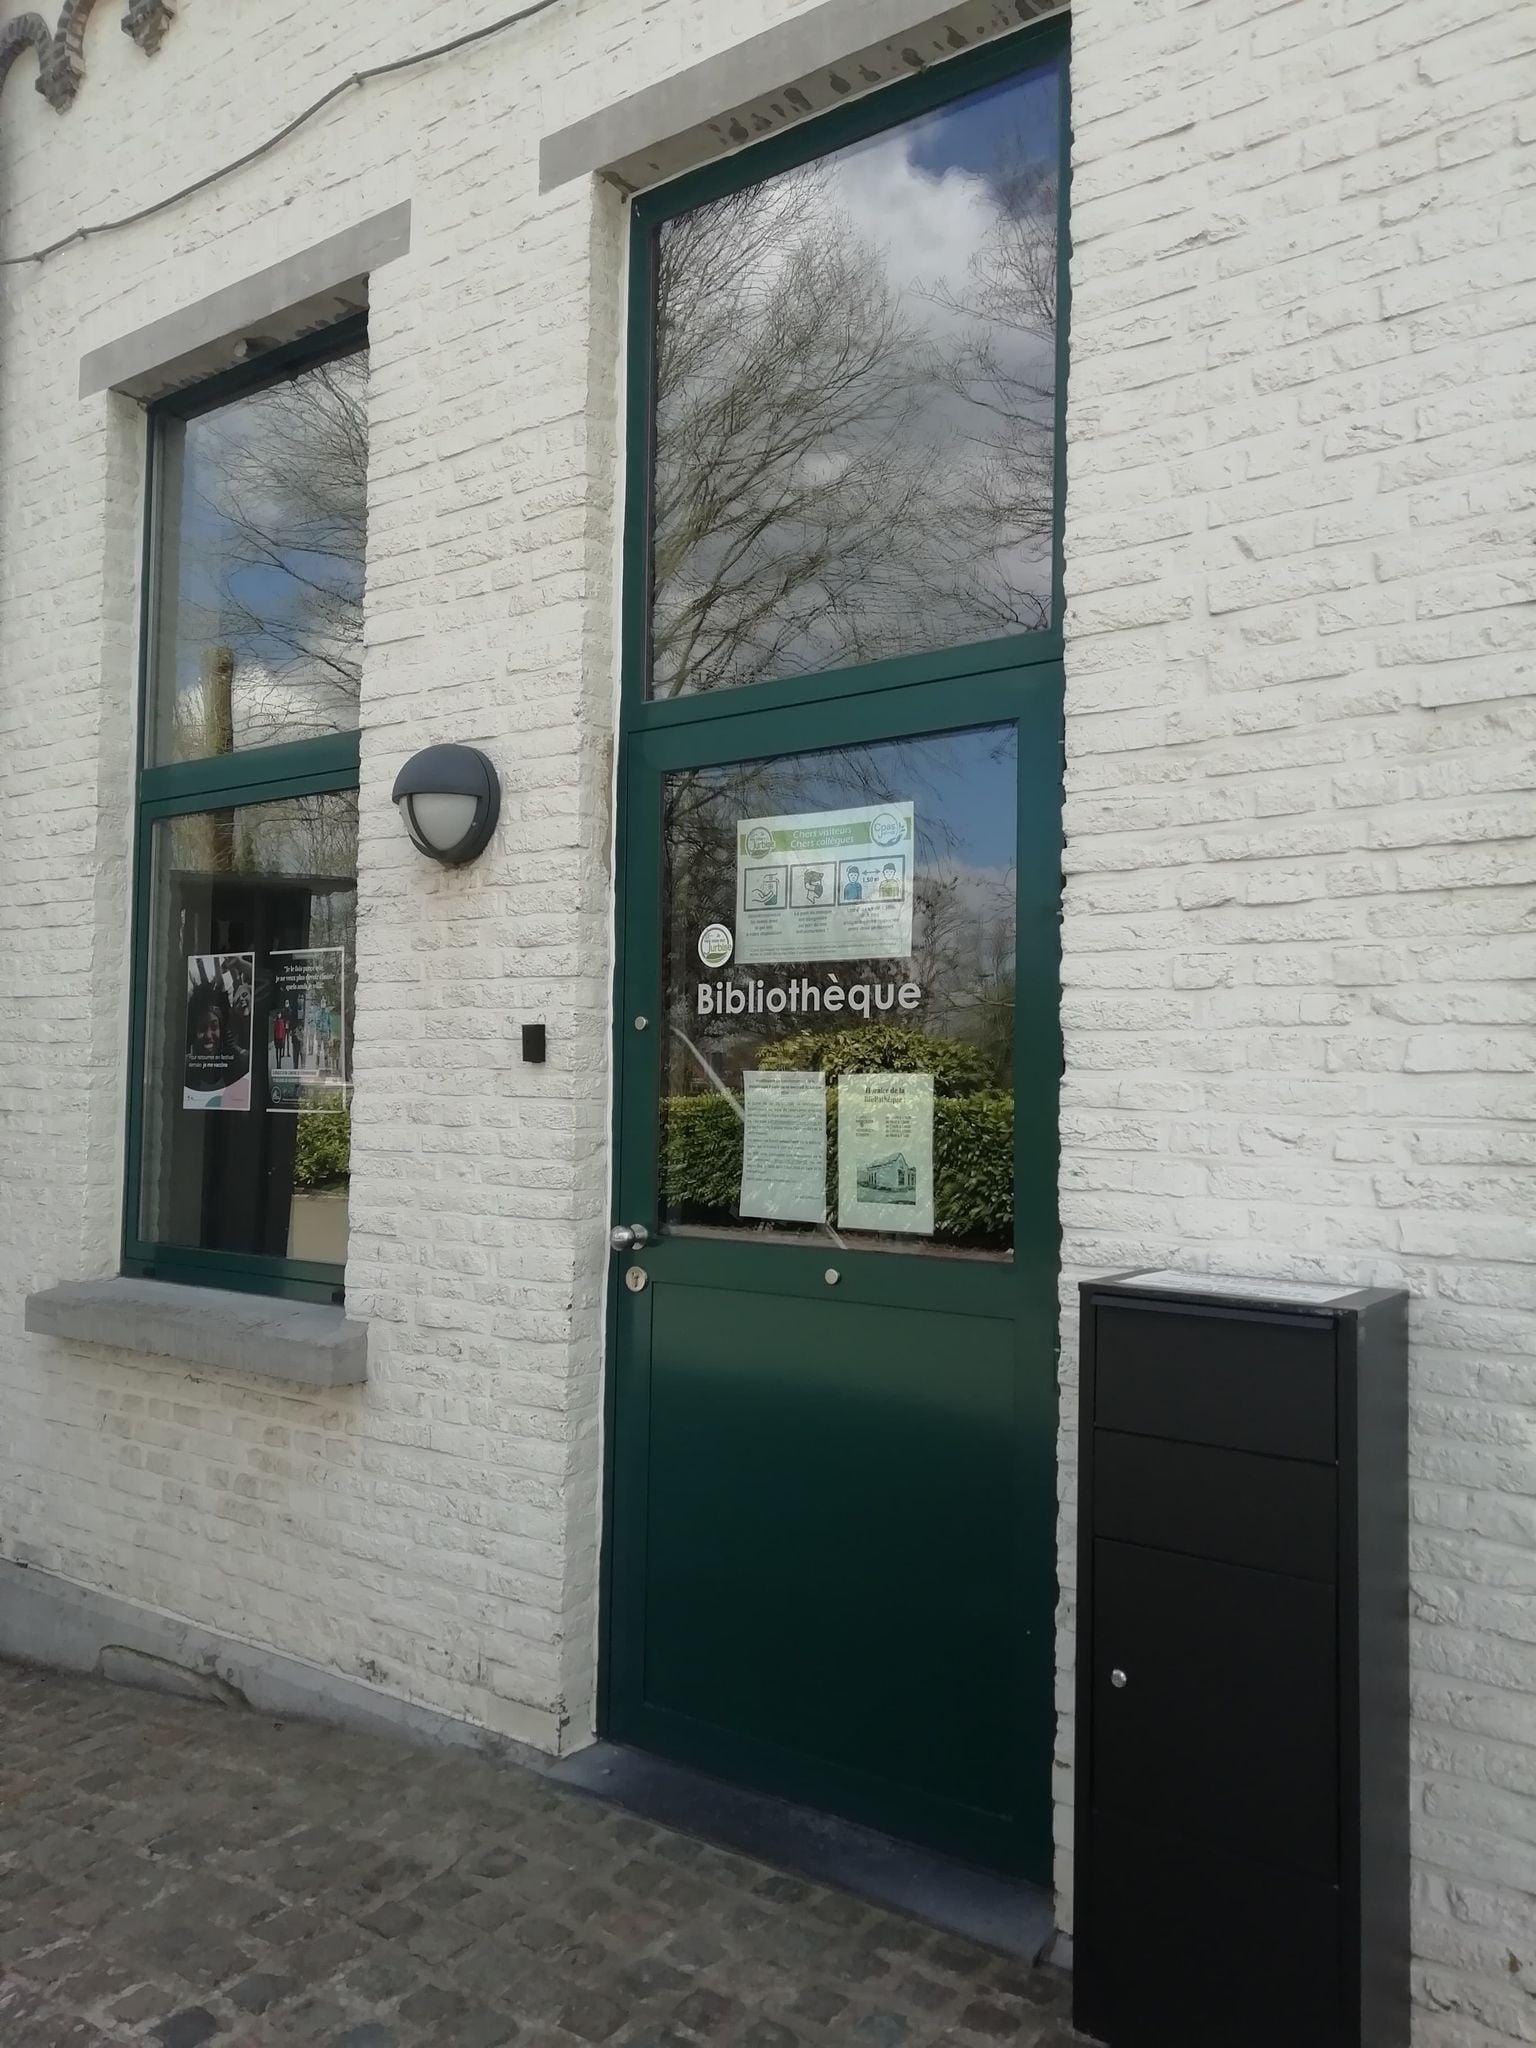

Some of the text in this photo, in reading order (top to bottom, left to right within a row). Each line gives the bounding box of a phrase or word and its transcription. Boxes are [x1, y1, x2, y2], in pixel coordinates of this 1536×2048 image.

[793, 827, 852, 839] Chers visiteurs
[874, 822, 896, 835] Cpas
[790, 839, 815, 849] Chers
[697, 973, 922, 1018] Bibliothèque
